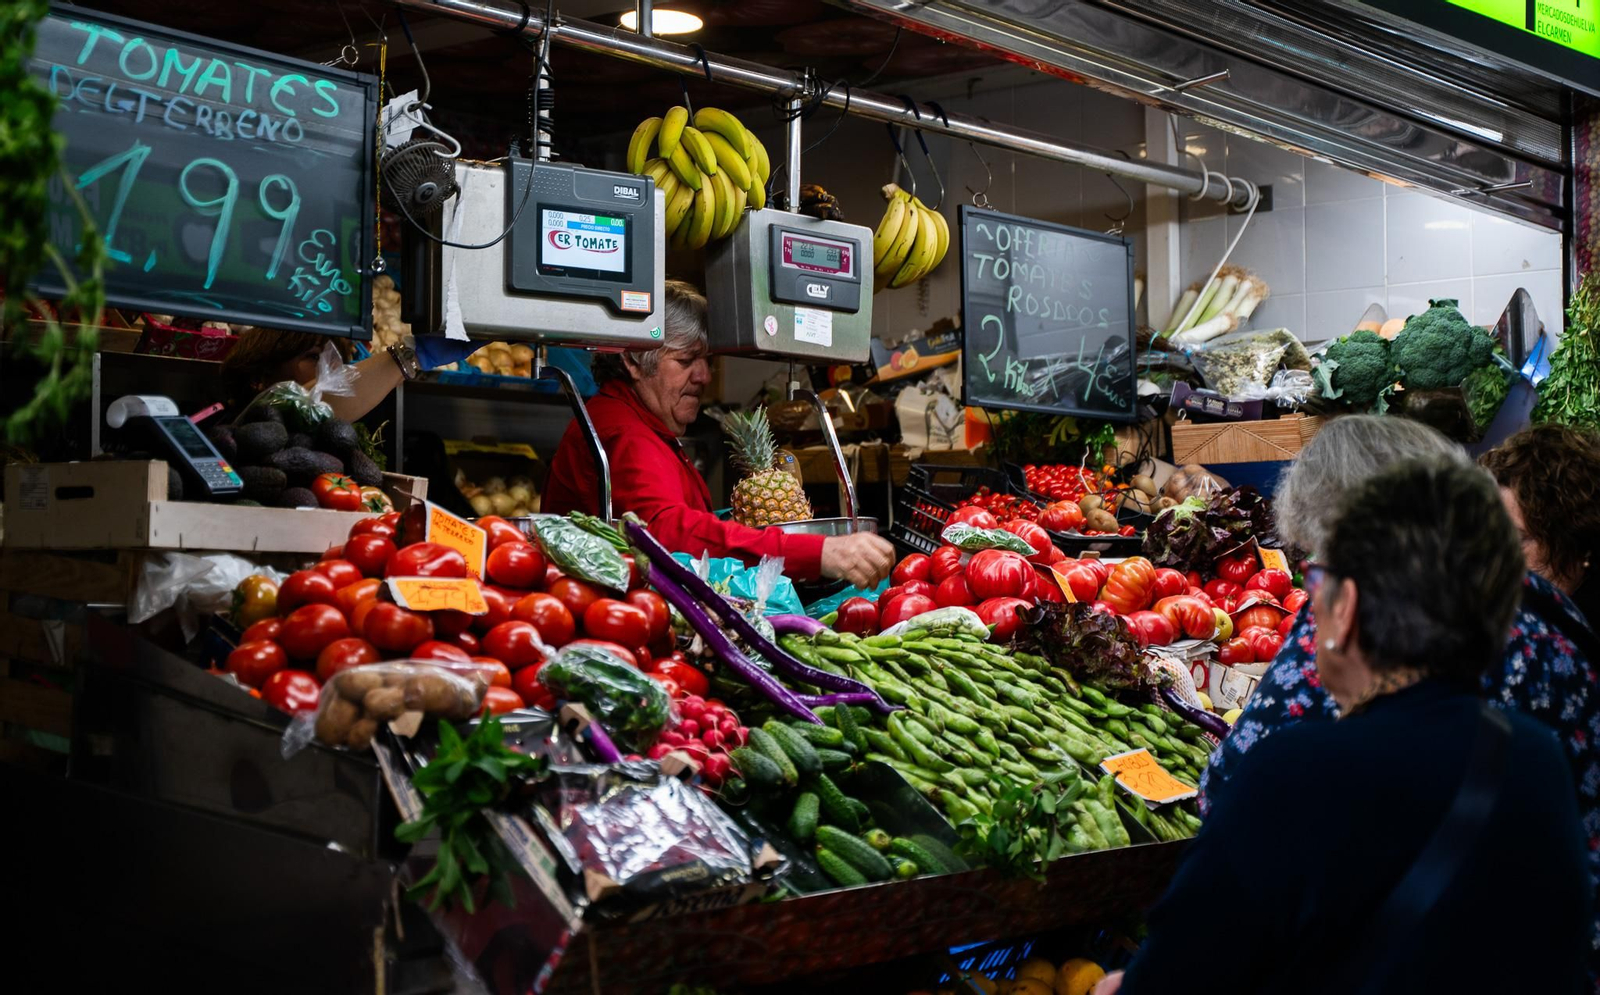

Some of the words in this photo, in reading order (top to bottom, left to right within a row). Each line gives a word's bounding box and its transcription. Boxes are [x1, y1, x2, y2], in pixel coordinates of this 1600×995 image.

[70, 21, 339, 118] TOMATES
[613, 185, 640, 198] DIBAL
[557, 233, 571, 246] ER
[575, 235, 618, 250] TOMATE
[973, 253, 1093, 300] TOMATES
[806, 283, 830, 299] CELY
[977, 314, 1004, 383] 2
[1077, 335, 1105, 402] 4
[433, 511, 477, 538] TOMATES
